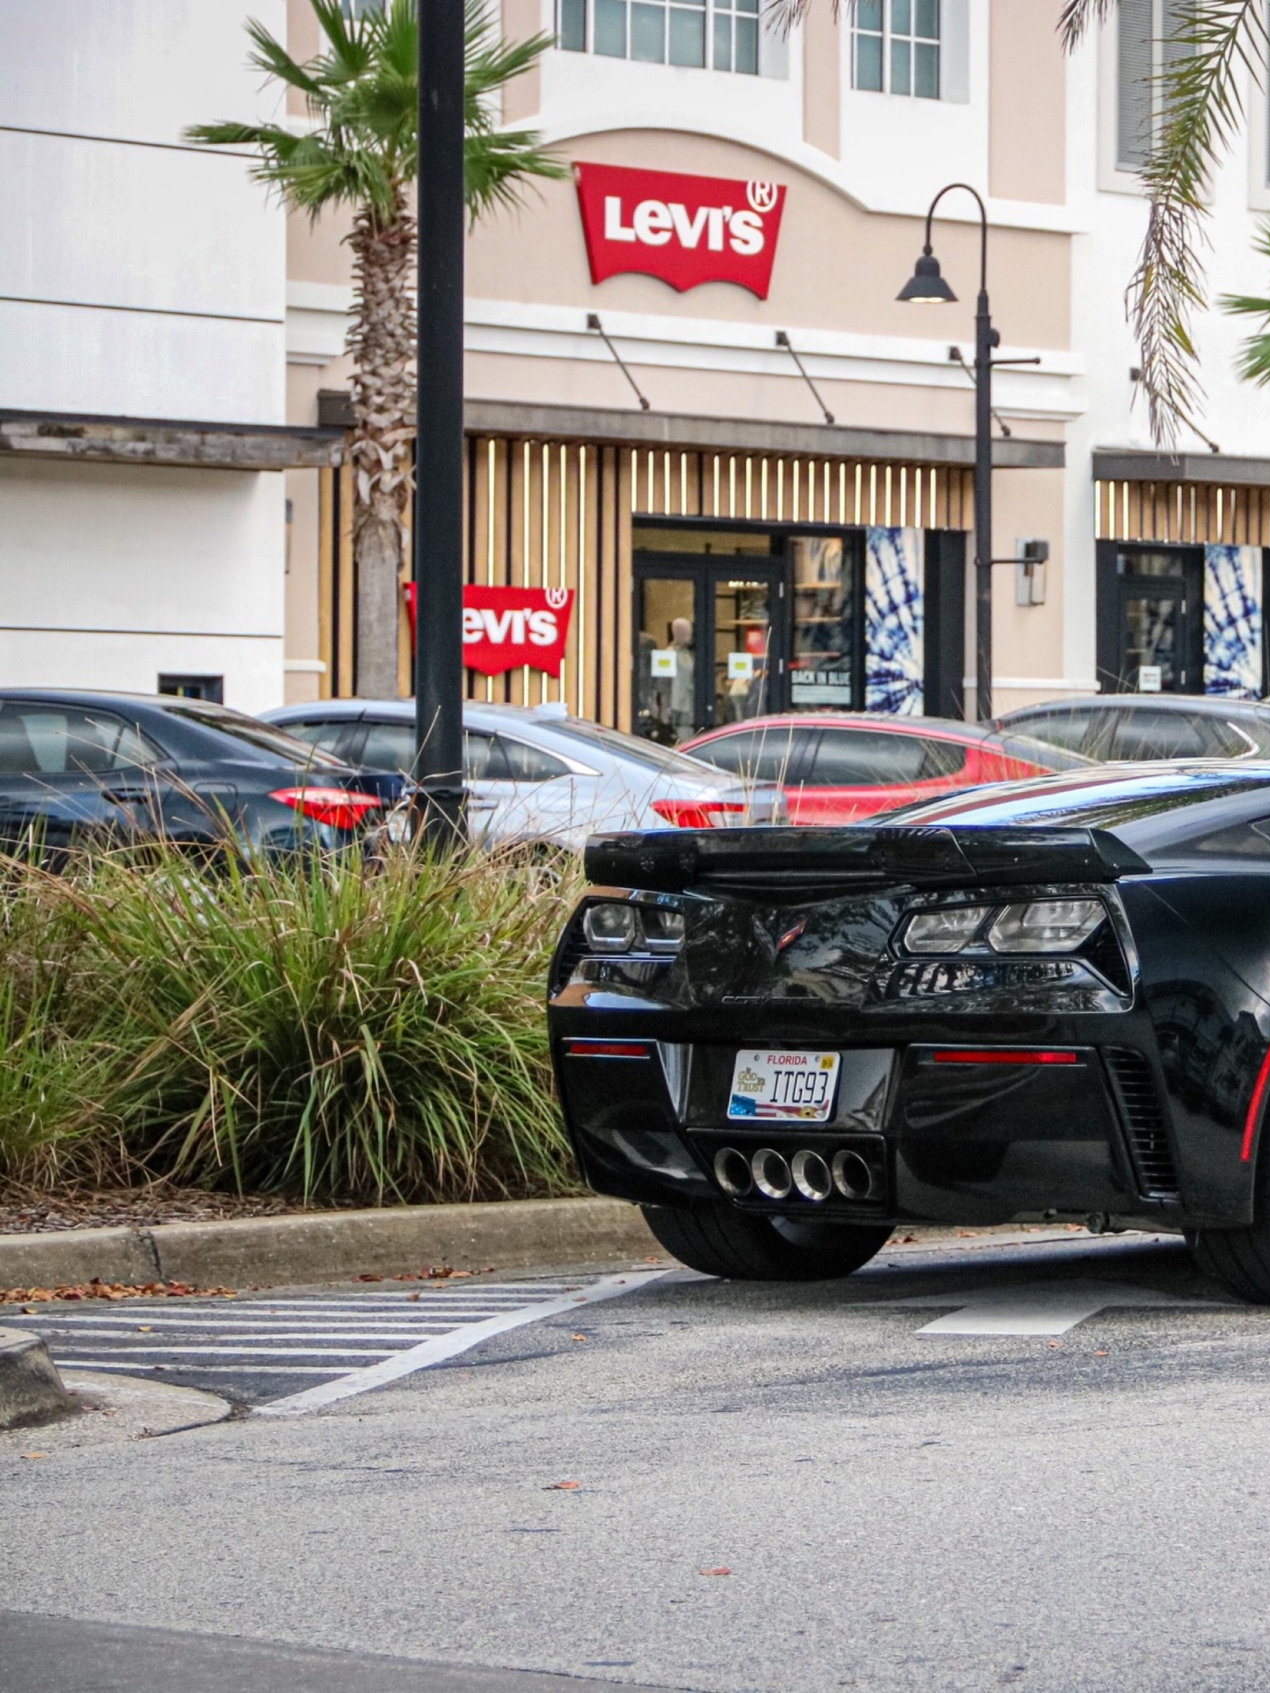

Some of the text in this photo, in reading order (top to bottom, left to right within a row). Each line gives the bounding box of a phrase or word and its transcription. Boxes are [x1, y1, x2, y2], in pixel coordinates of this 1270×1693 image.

[766, 1054, 808, 1066] FLORIDA
[738, 1071, 758, 1082] GOD
[737, 1081, 765, 1093] TRUST
[769, 1070, 829, 1104] ITG93
